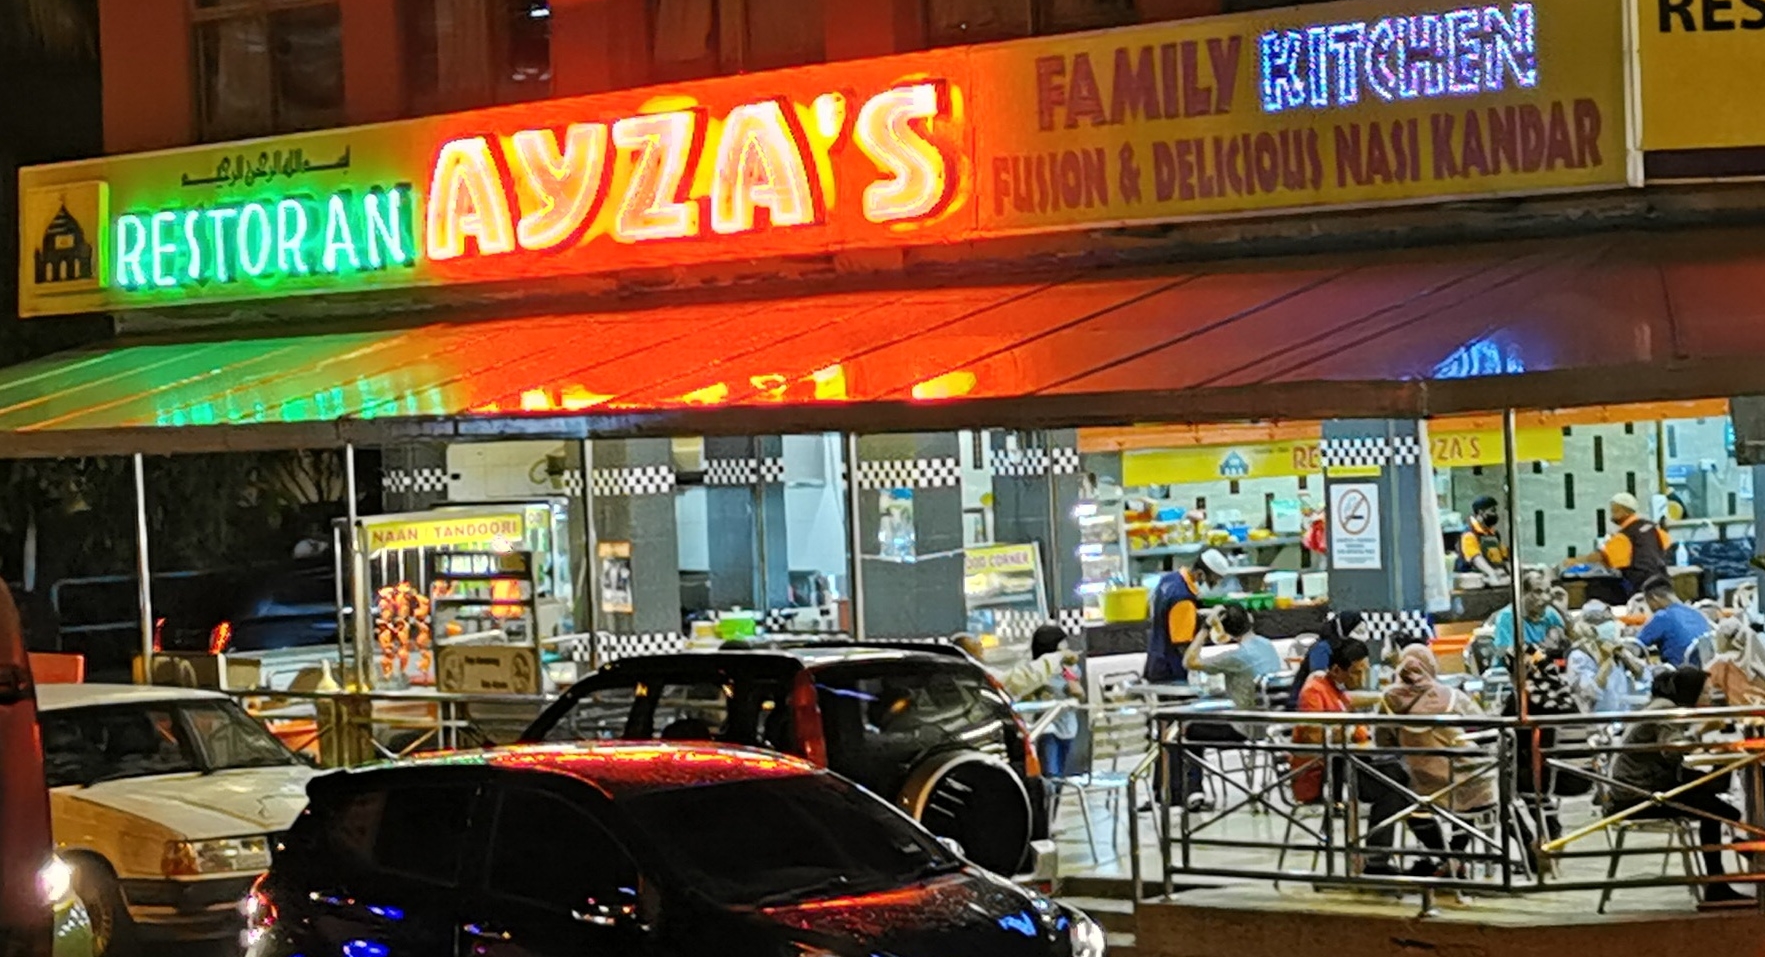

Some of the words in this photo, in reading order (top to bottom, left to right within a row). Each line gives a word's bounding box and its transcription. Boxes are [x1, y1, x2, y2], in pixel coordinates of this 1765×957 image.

[1036, 34, 1243, 132] FAMILY
[1257, 1, 1540, 113] KITCHEN
[114, 182, 415, 289] RESTORAN
[426, 80, 955, 261] AYZA'S
[992, 146, 1109, 216] FUSION
[1119, 137, 1141, 205] &
[1154, 126, 1322, 203] DELICIOUS
[1333, 118, 1421, 189] NASI
[1431, 98, 1603, 178] KANDAR
[373, 527, 419, 544] NAAN
[433, 519, 518, 539] TANDOORI
